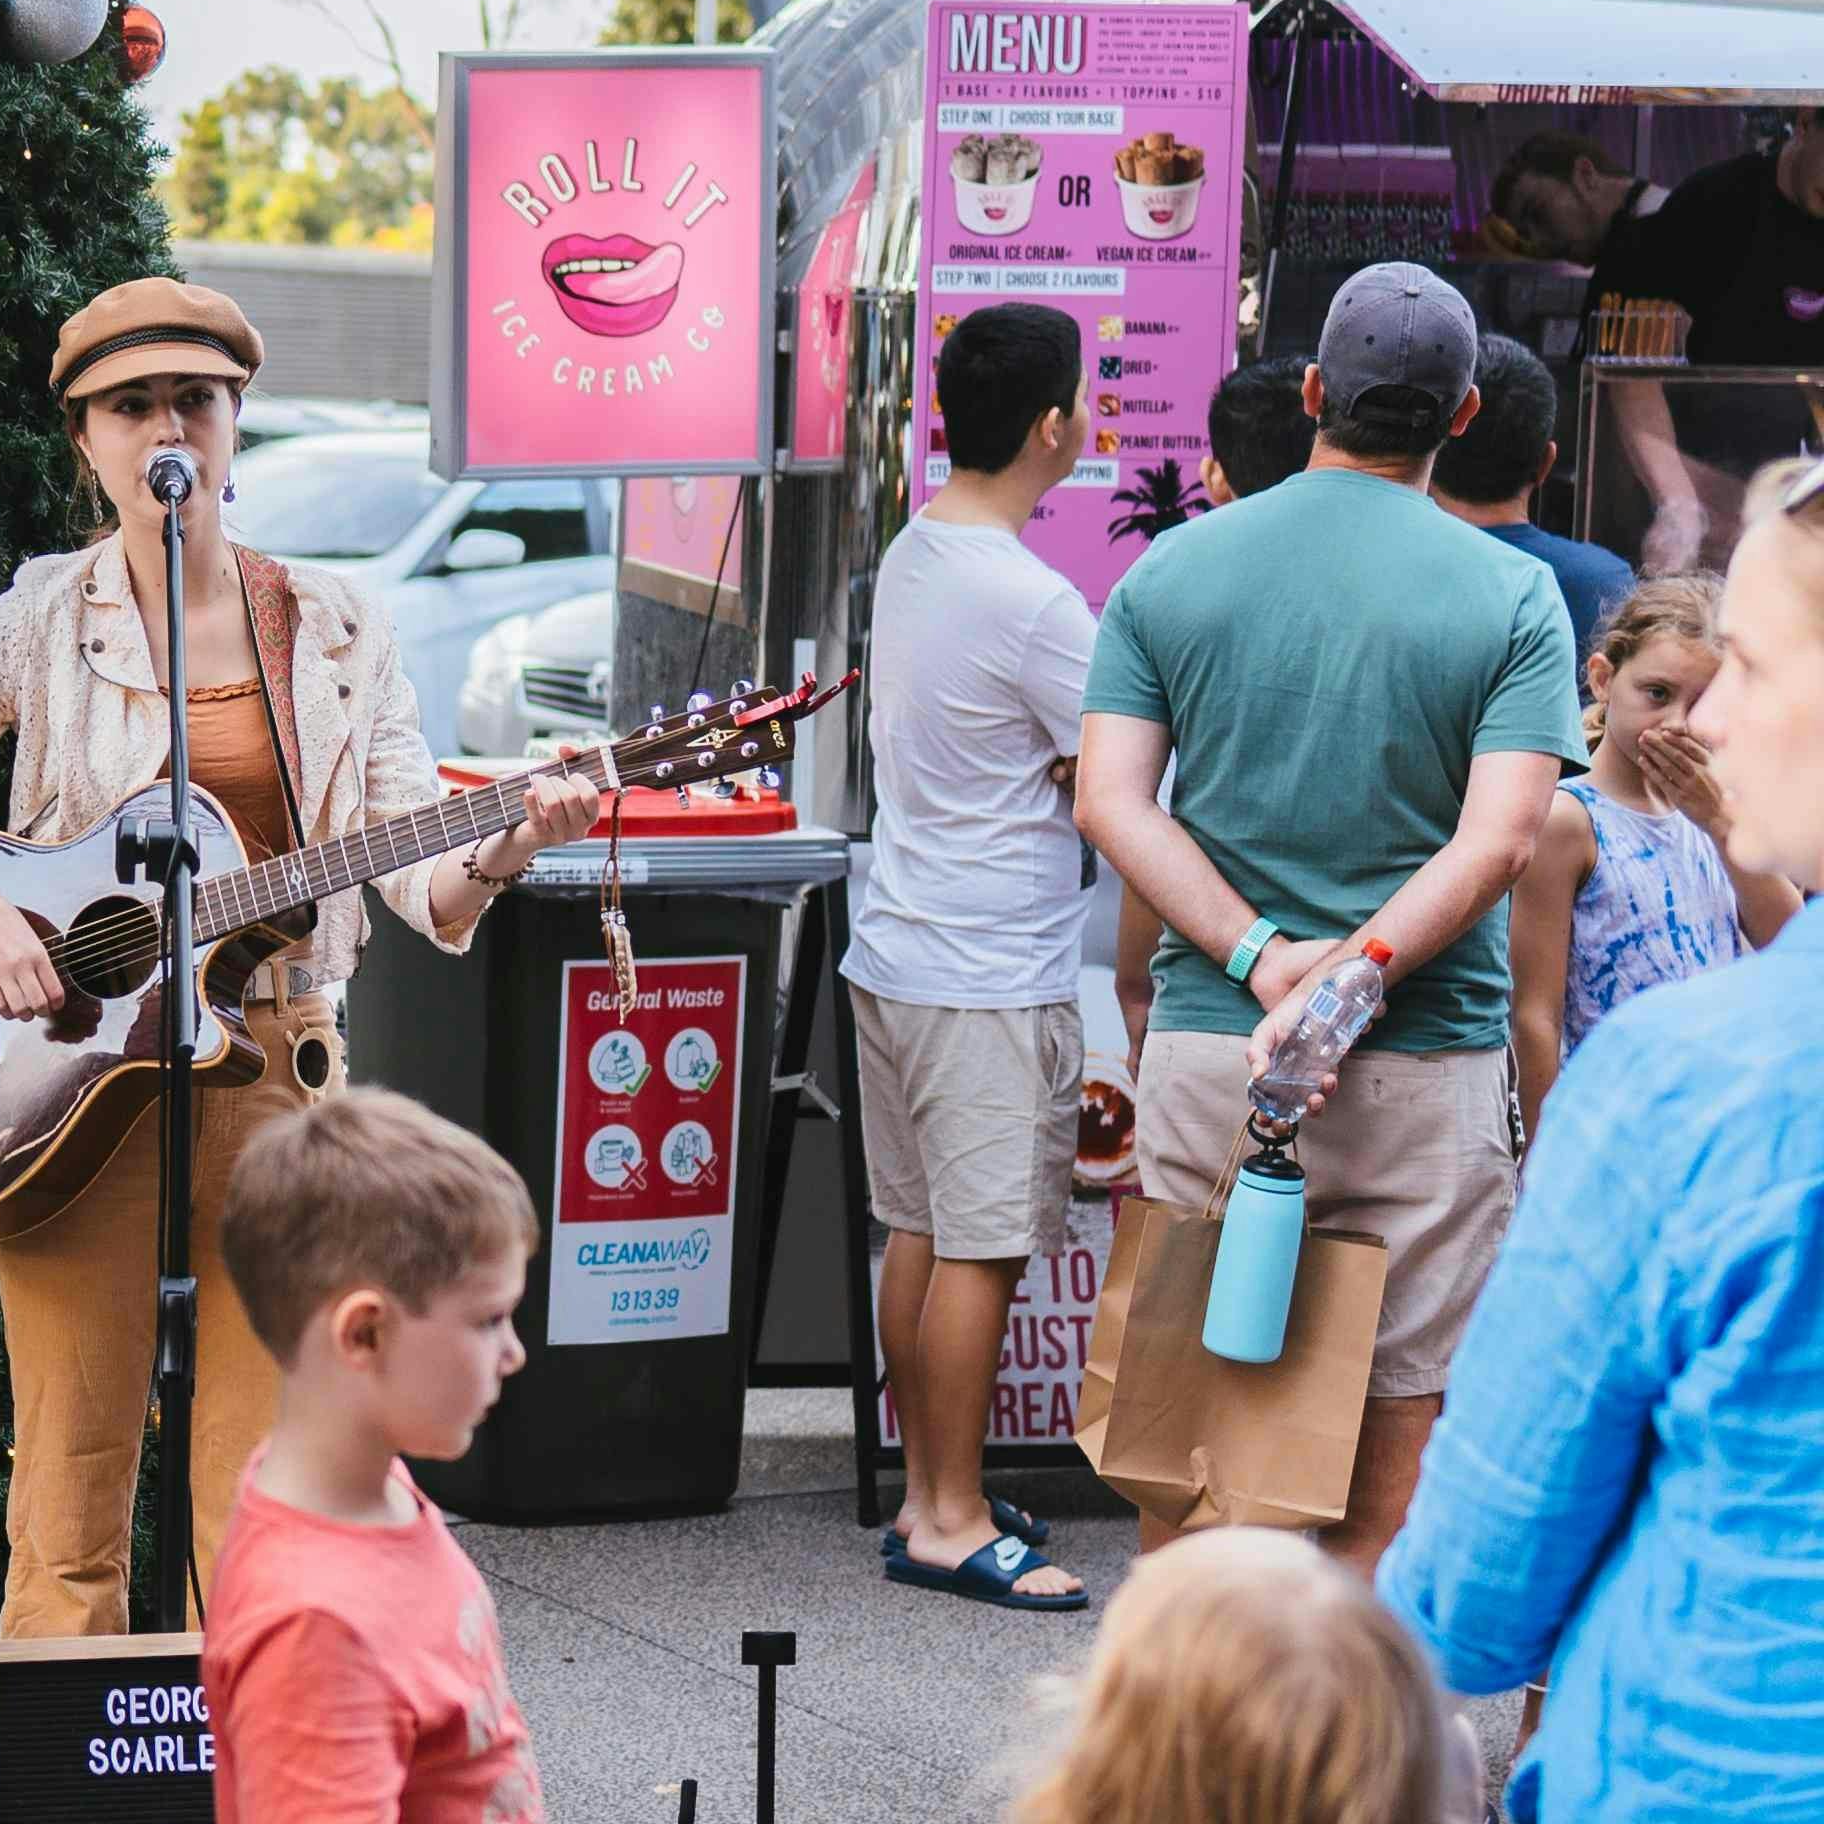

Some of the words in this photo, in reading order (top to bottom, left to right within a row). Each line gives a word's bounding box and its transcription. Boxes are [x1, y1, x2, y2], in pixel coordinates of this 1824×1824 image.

[948, 13, 1087, 75] MENU
[957, 83, 989, 97] BASE
[1009, 84, 1016, 98] 2
[1023, 84, 1088, 98] FLAVOURS
[1122, 86, 1177, 99] TOPPING
[1197, 87, 1222, 100] $10
[941, 108, 969, 125] STEP
[972, 109, 993, 125] ONE
[1009, 109, 1051, 126] CHOOSE
[1056, 110, 1086, 126] YOUR
[1087, 111, 1116, 127] BASE
[501, 136, 644, 228] ROLL
[663, 160, 728, 228] IT
[1057, 175, 1091, 207] OR
[948, 244, 1000, 260] ORIGINAL
[1003, 245, 1022, 260] ICE
[1096, 245, 1133, 262] VEGAN
[1136, 246, 1153, 262] ICE
[935, 271, 965, 286] STEP
[967, 272, 991, 286] TWO
[1005, 272, 1050, 288] CHOOSE
[1052, 273, 1060, 288] 2
[1062, 272, 1119, 289] FLAVOURS
[492, 298, 542, 359] ICE
[552, 353, 675, 396] CREAM
[1120, 435, 1160, 450] PEANUT
[1072, 463, 1113, 481] OPPING
[587, 987, 662, 1011] Genral
[666, 986, 725, 1009] Waste
[576, 1236, 705, 1266] CLEANAWAY
[1041, 1249, 1096, 1304] TO
[992, 1381, 1081, 1438] REA
[106, 1685, 210, 1726] GEORG
[88, 1733, 218, 1776] SCARLE
